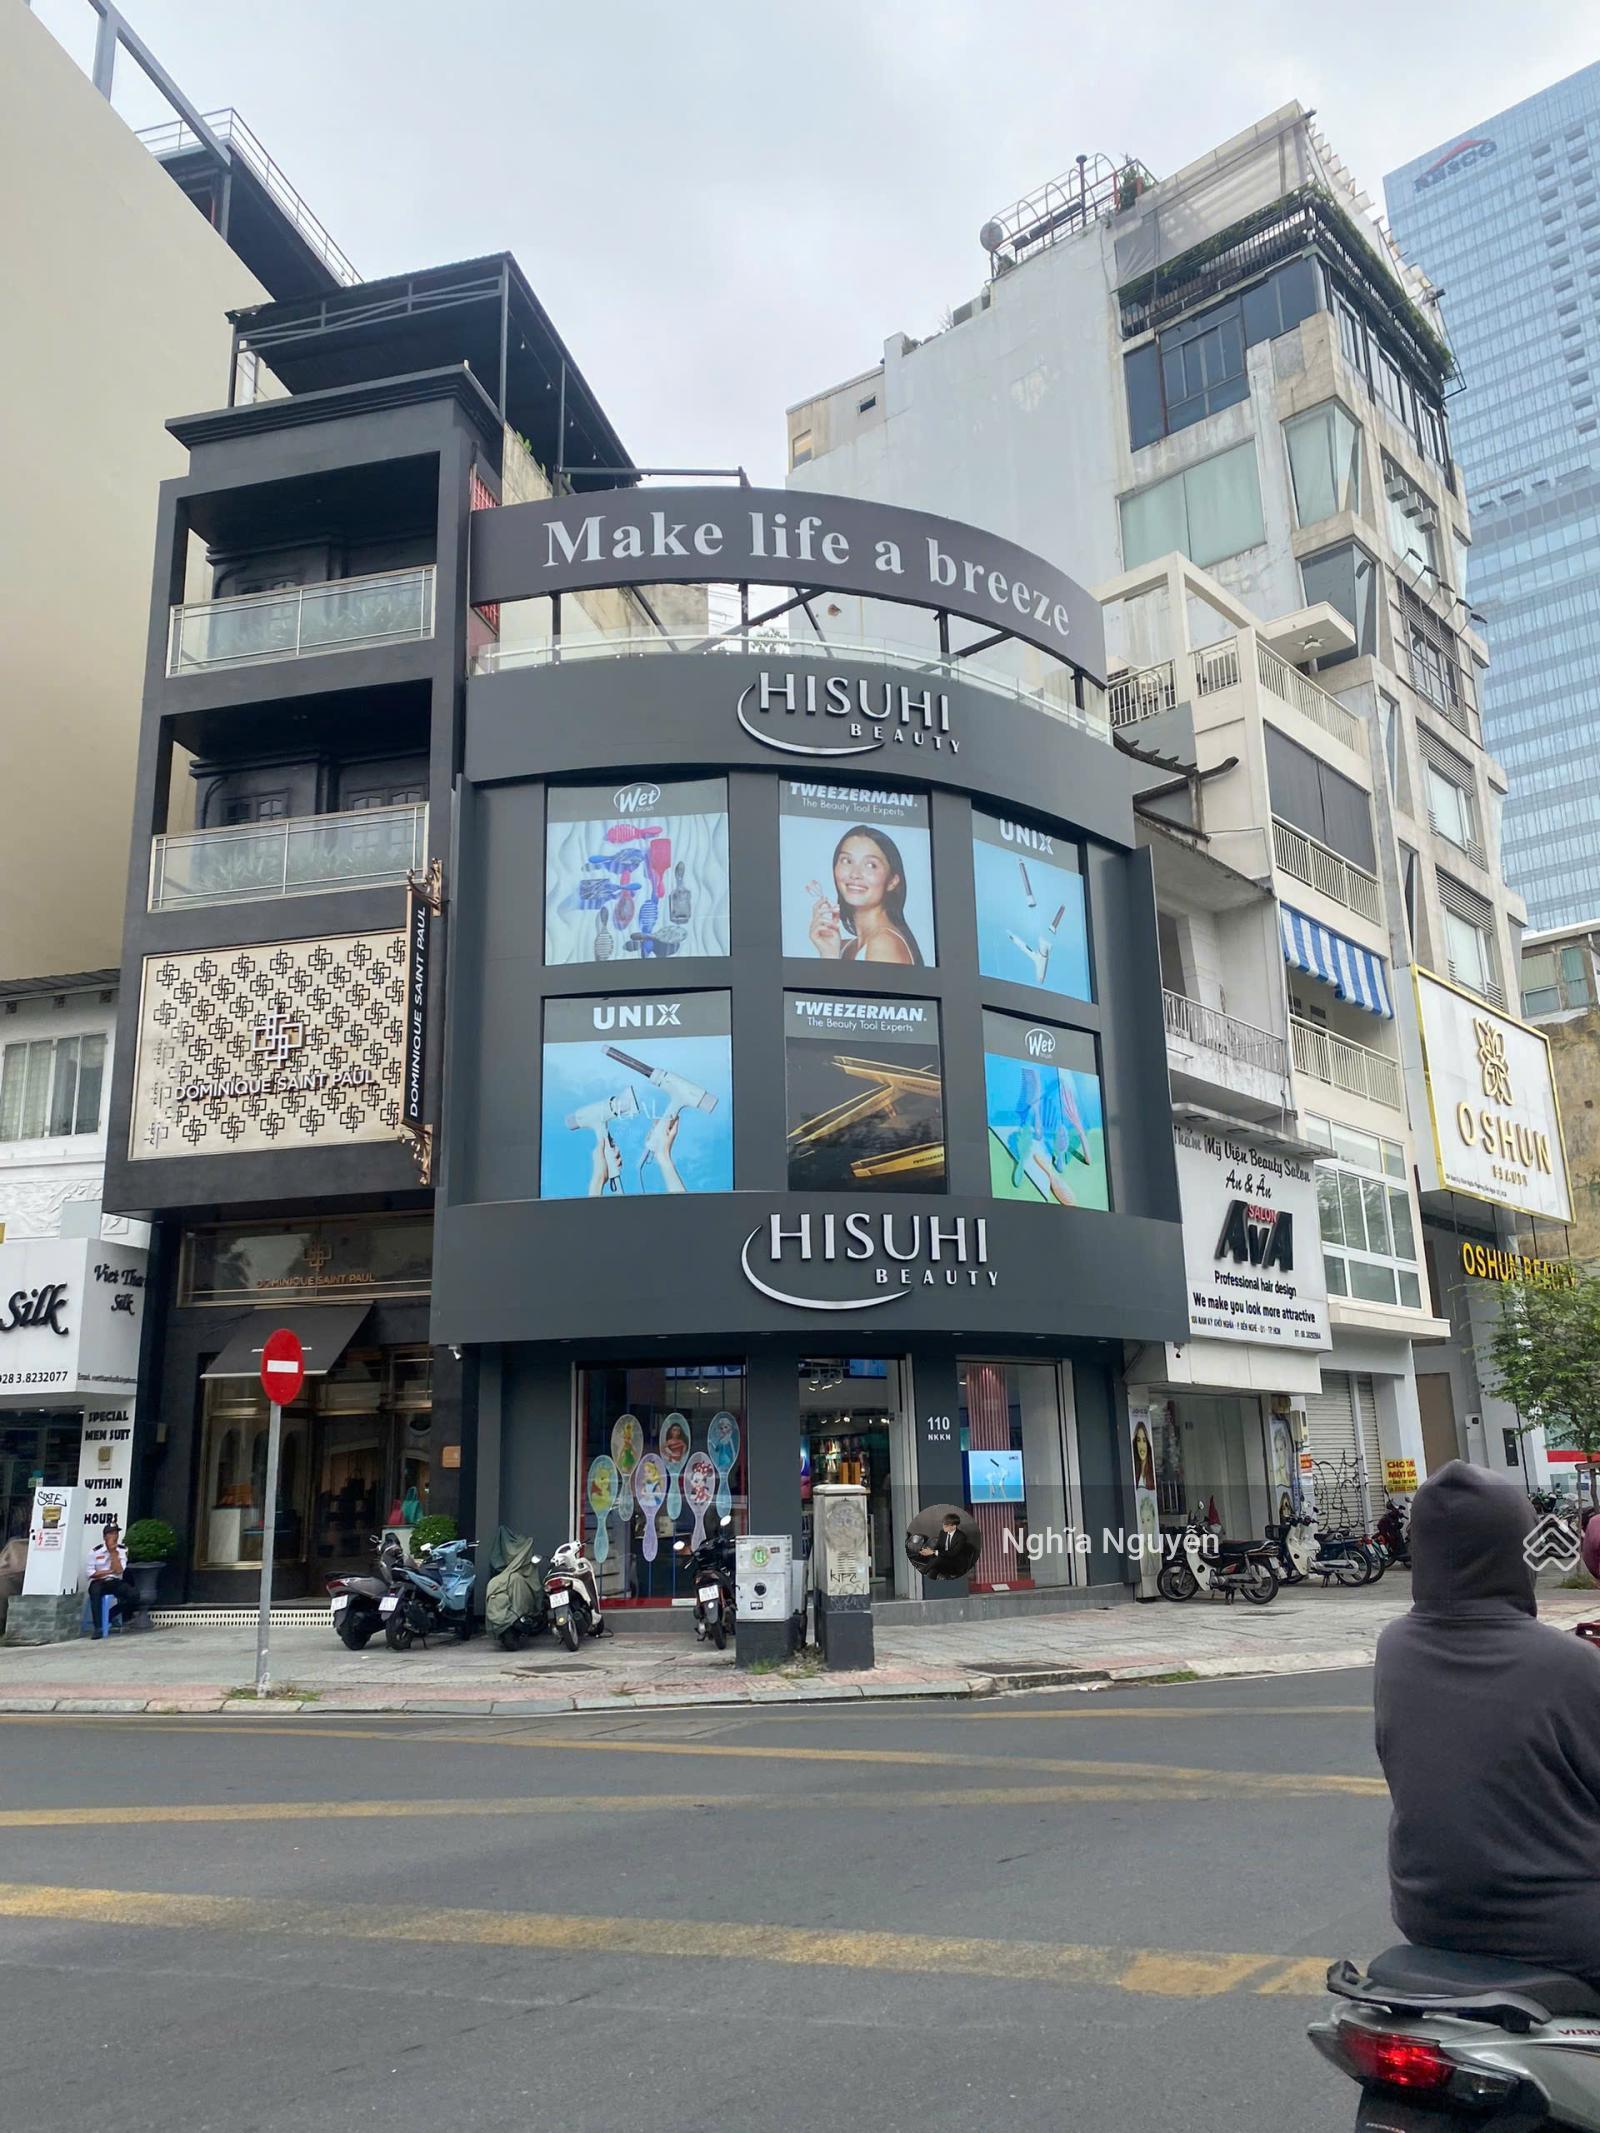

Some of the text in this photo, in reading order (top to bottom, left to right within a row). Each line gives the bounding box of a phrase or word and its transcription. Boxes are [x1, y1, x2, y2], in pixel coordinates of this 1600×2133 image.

[542, 511, 1072, 637] Make life a breeze
[759, 671, 951, 732] HISUHI
[849, 722, 961, 754] BEAUTY
[619, 787, 657, 813] Wet
[802, 797, 905, 817] The Beauty Tool Experts
[1000, 818, 1054, 855] UNIX
[410, 906, 426, 1118] DOMINIQUE SAINT PAUL
[593, 1003, 681, 1030] UNIX
[808, 1016, 913, 1033] The Beauty Tool Experts
[1028, 1033, 1055, 1057] Wet
[175, 1069, 375, 1101] DOMINIQUE SAINT PAUL
[1457, 1101, 1552, 1175] OSHUN
[1249, 1148, 1283, 1178] Beauty
[1283, 1158, 1311, 1182] Salon
[1225, 1169, 1242, 1191] An
[1244, 1173, 1253, 1194] &
[1246, 1203, 1278, 1224] SALON
[769, 1213, 988, 1264] HISUHI
[348, 1271, 376, 1283] PAUL
[875, 1268, 998, 1287] BEAUTY
[1214, 1270, 1297, 1299] Professional hair design
[0, 1283, 69, 1336] Silk
[111, 1293, 136, 1316] Silk
[1193, 1292, 1317, 1324] We make you look more attractive
[15, 1370, 68, 1384] 3.8232077
[88, 1410, 129, 1423] SPECIAL
[927, 1416, 950, 1431] 110
[84, 1428, 131, 1441] MEN SUIT
[84, 1478, 123, 1490] WITHIN
[95, 1497, 107, 1507] 24
[84, 1513, 118, 1524] HOURS
